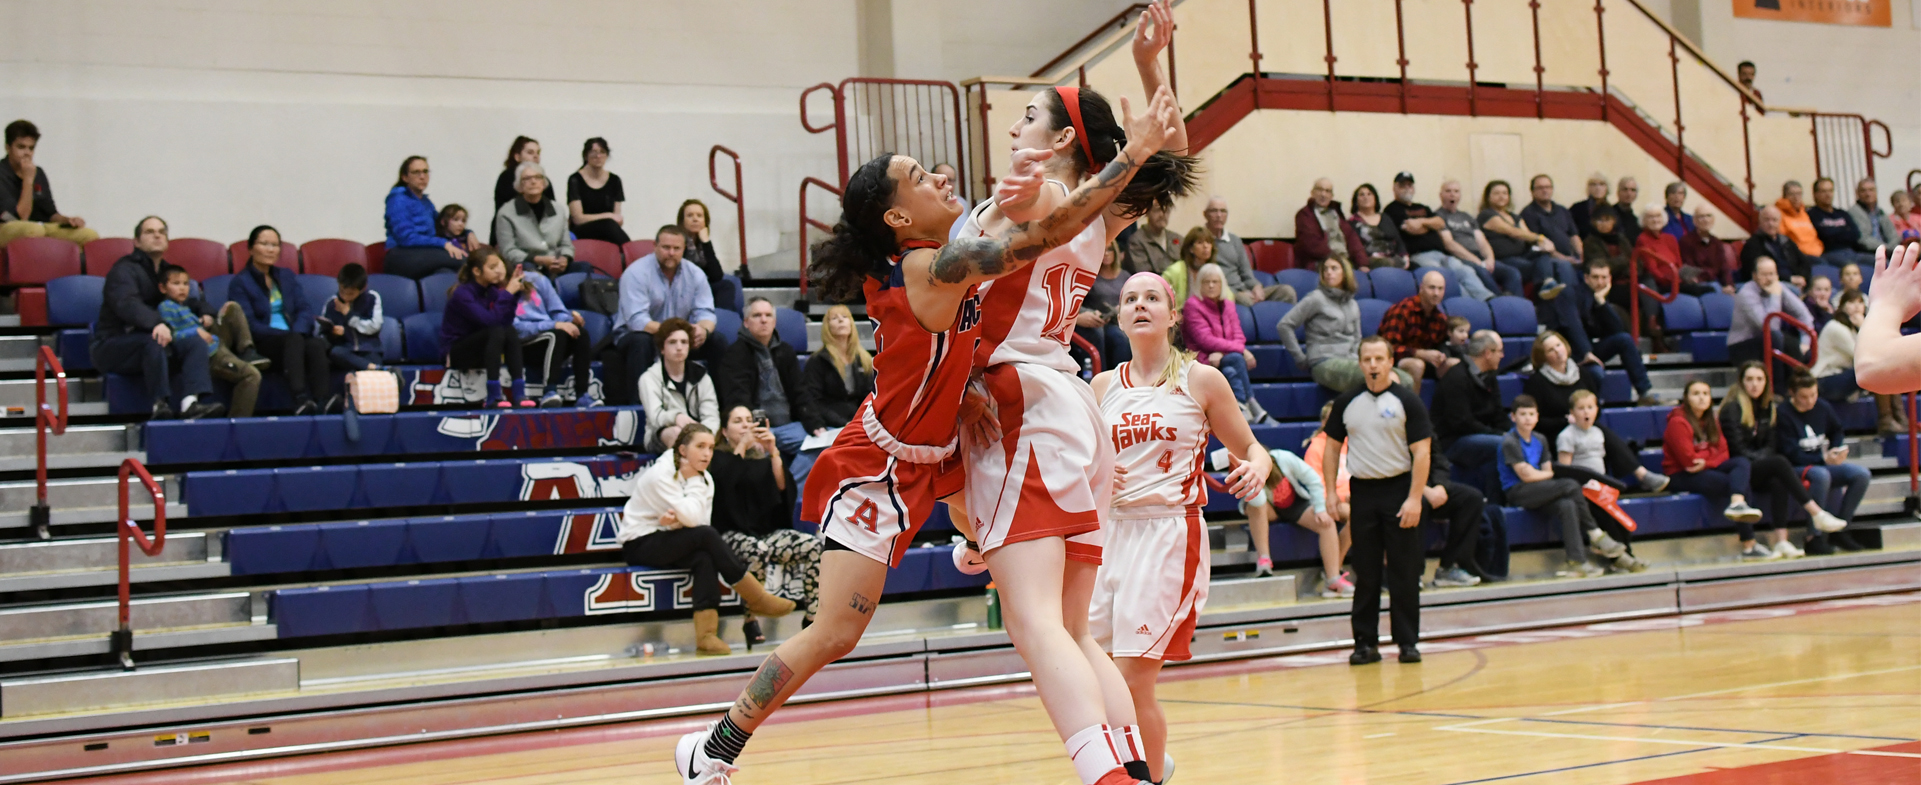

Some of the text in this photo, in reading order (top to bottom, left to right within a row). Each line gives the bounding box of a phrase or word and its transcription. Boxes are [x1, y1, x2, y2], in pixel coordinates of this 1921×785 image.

[1120, 412, 1151, 427] Sea
[1156, 448, 1174, 474] 4
[845, 497, 880, 535] A
